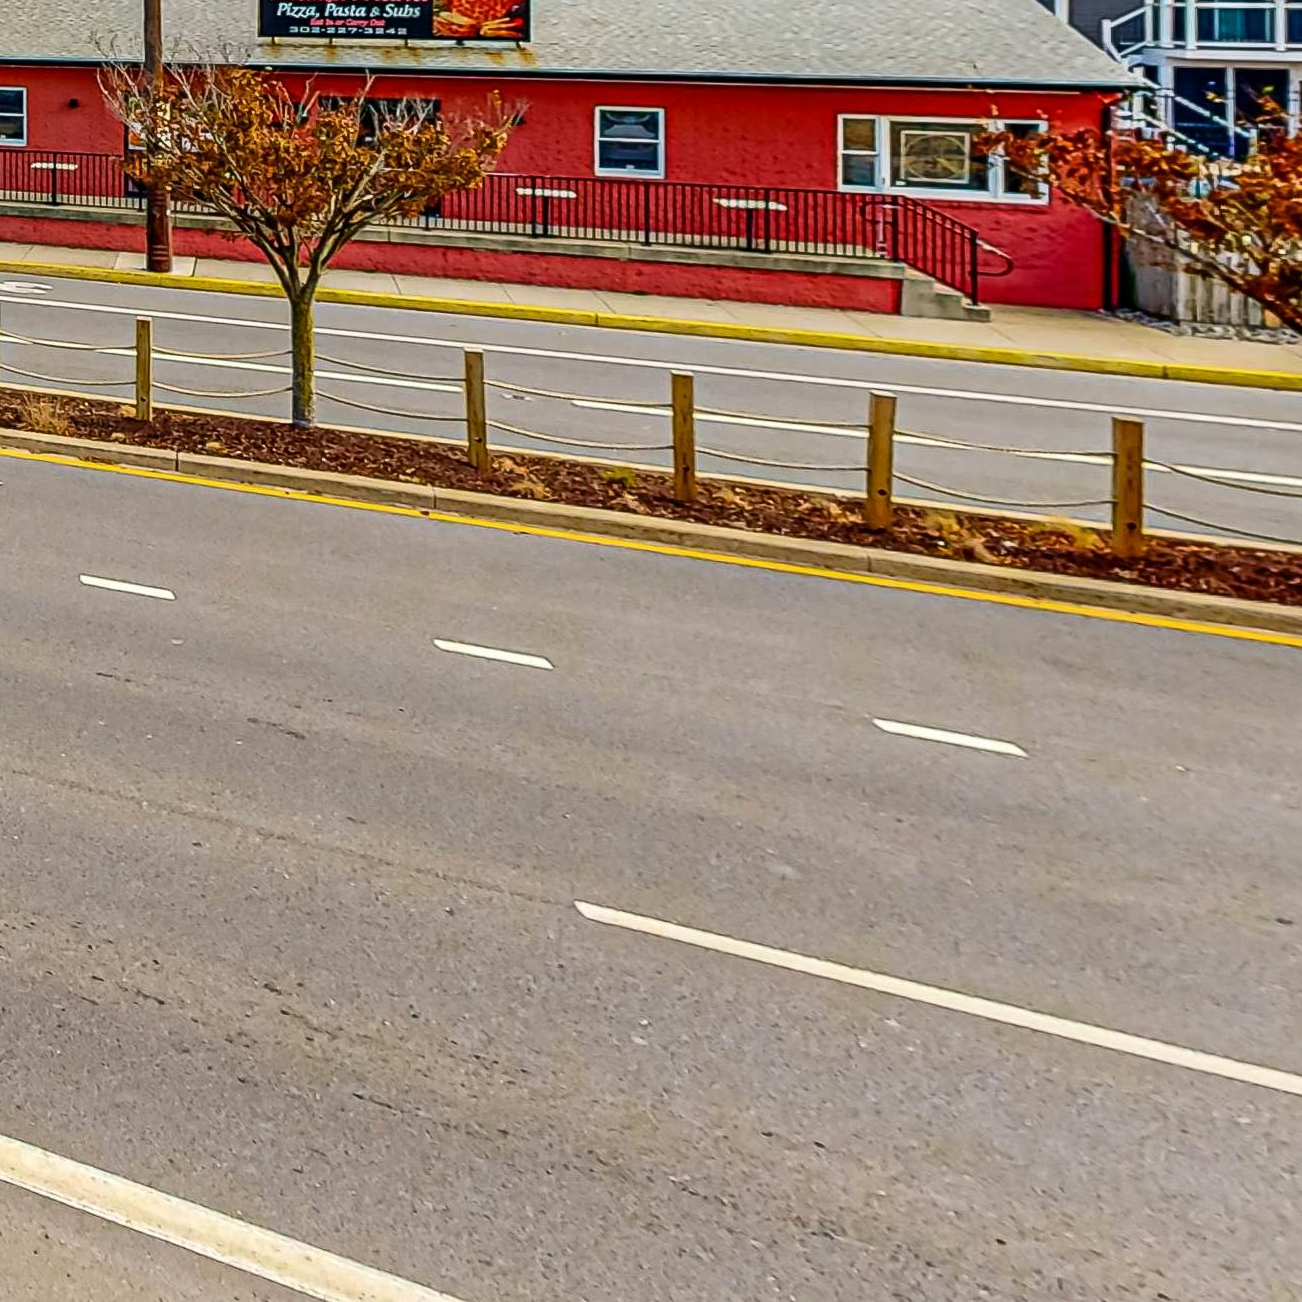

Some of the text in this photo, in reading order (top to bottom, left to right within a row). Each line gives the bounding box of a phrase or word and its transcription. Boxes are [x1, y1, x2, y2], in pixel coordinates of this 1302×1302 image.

[276, 2, 421, 18] Pizza, Pasta & Subs
